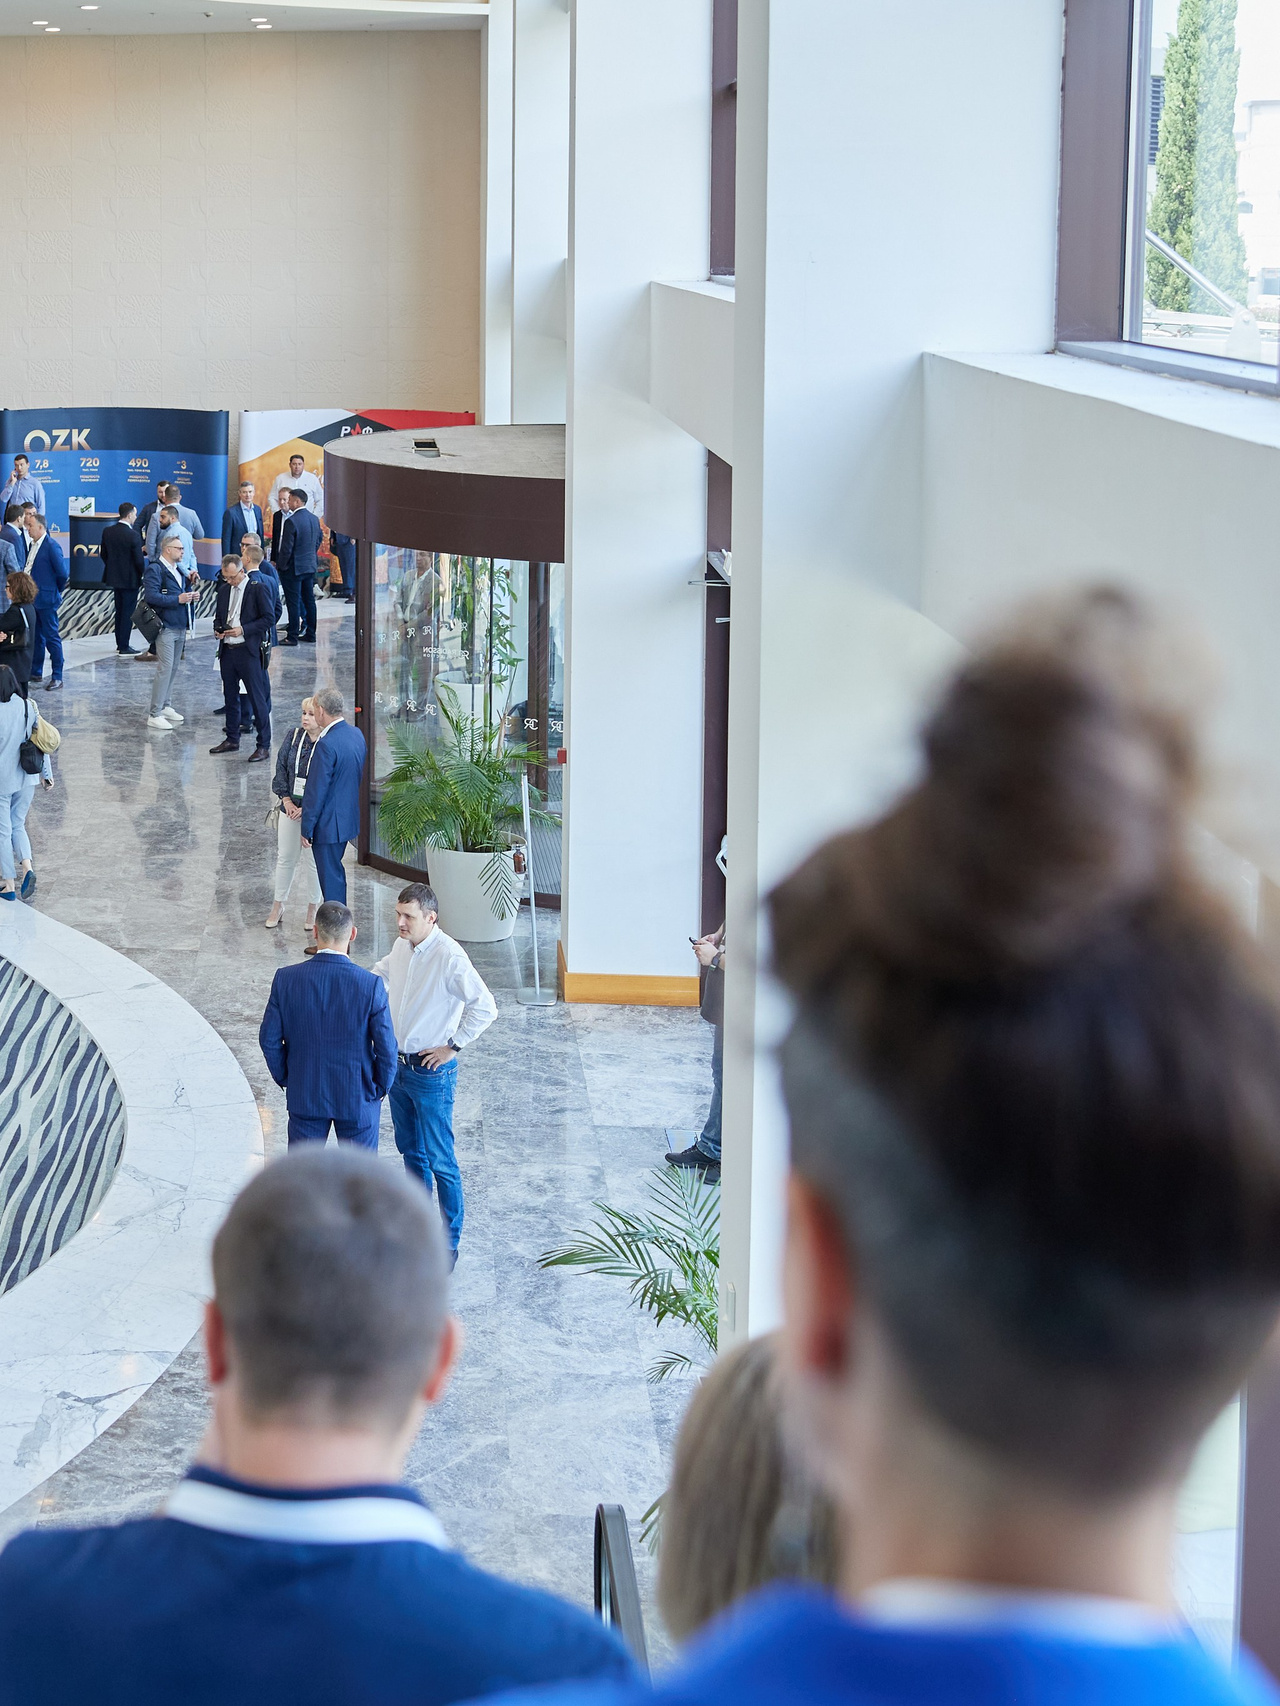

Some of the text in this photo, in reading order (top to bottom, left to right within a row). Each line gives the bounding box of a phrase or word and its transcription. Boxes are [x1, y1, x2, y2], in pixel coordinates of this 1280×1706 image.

[23, 428, 93, 452] OZK
[35, 459, 49, 470] 7,8
[80, 458, 100, 467] 720
[128, 458, 149, 467] 490
